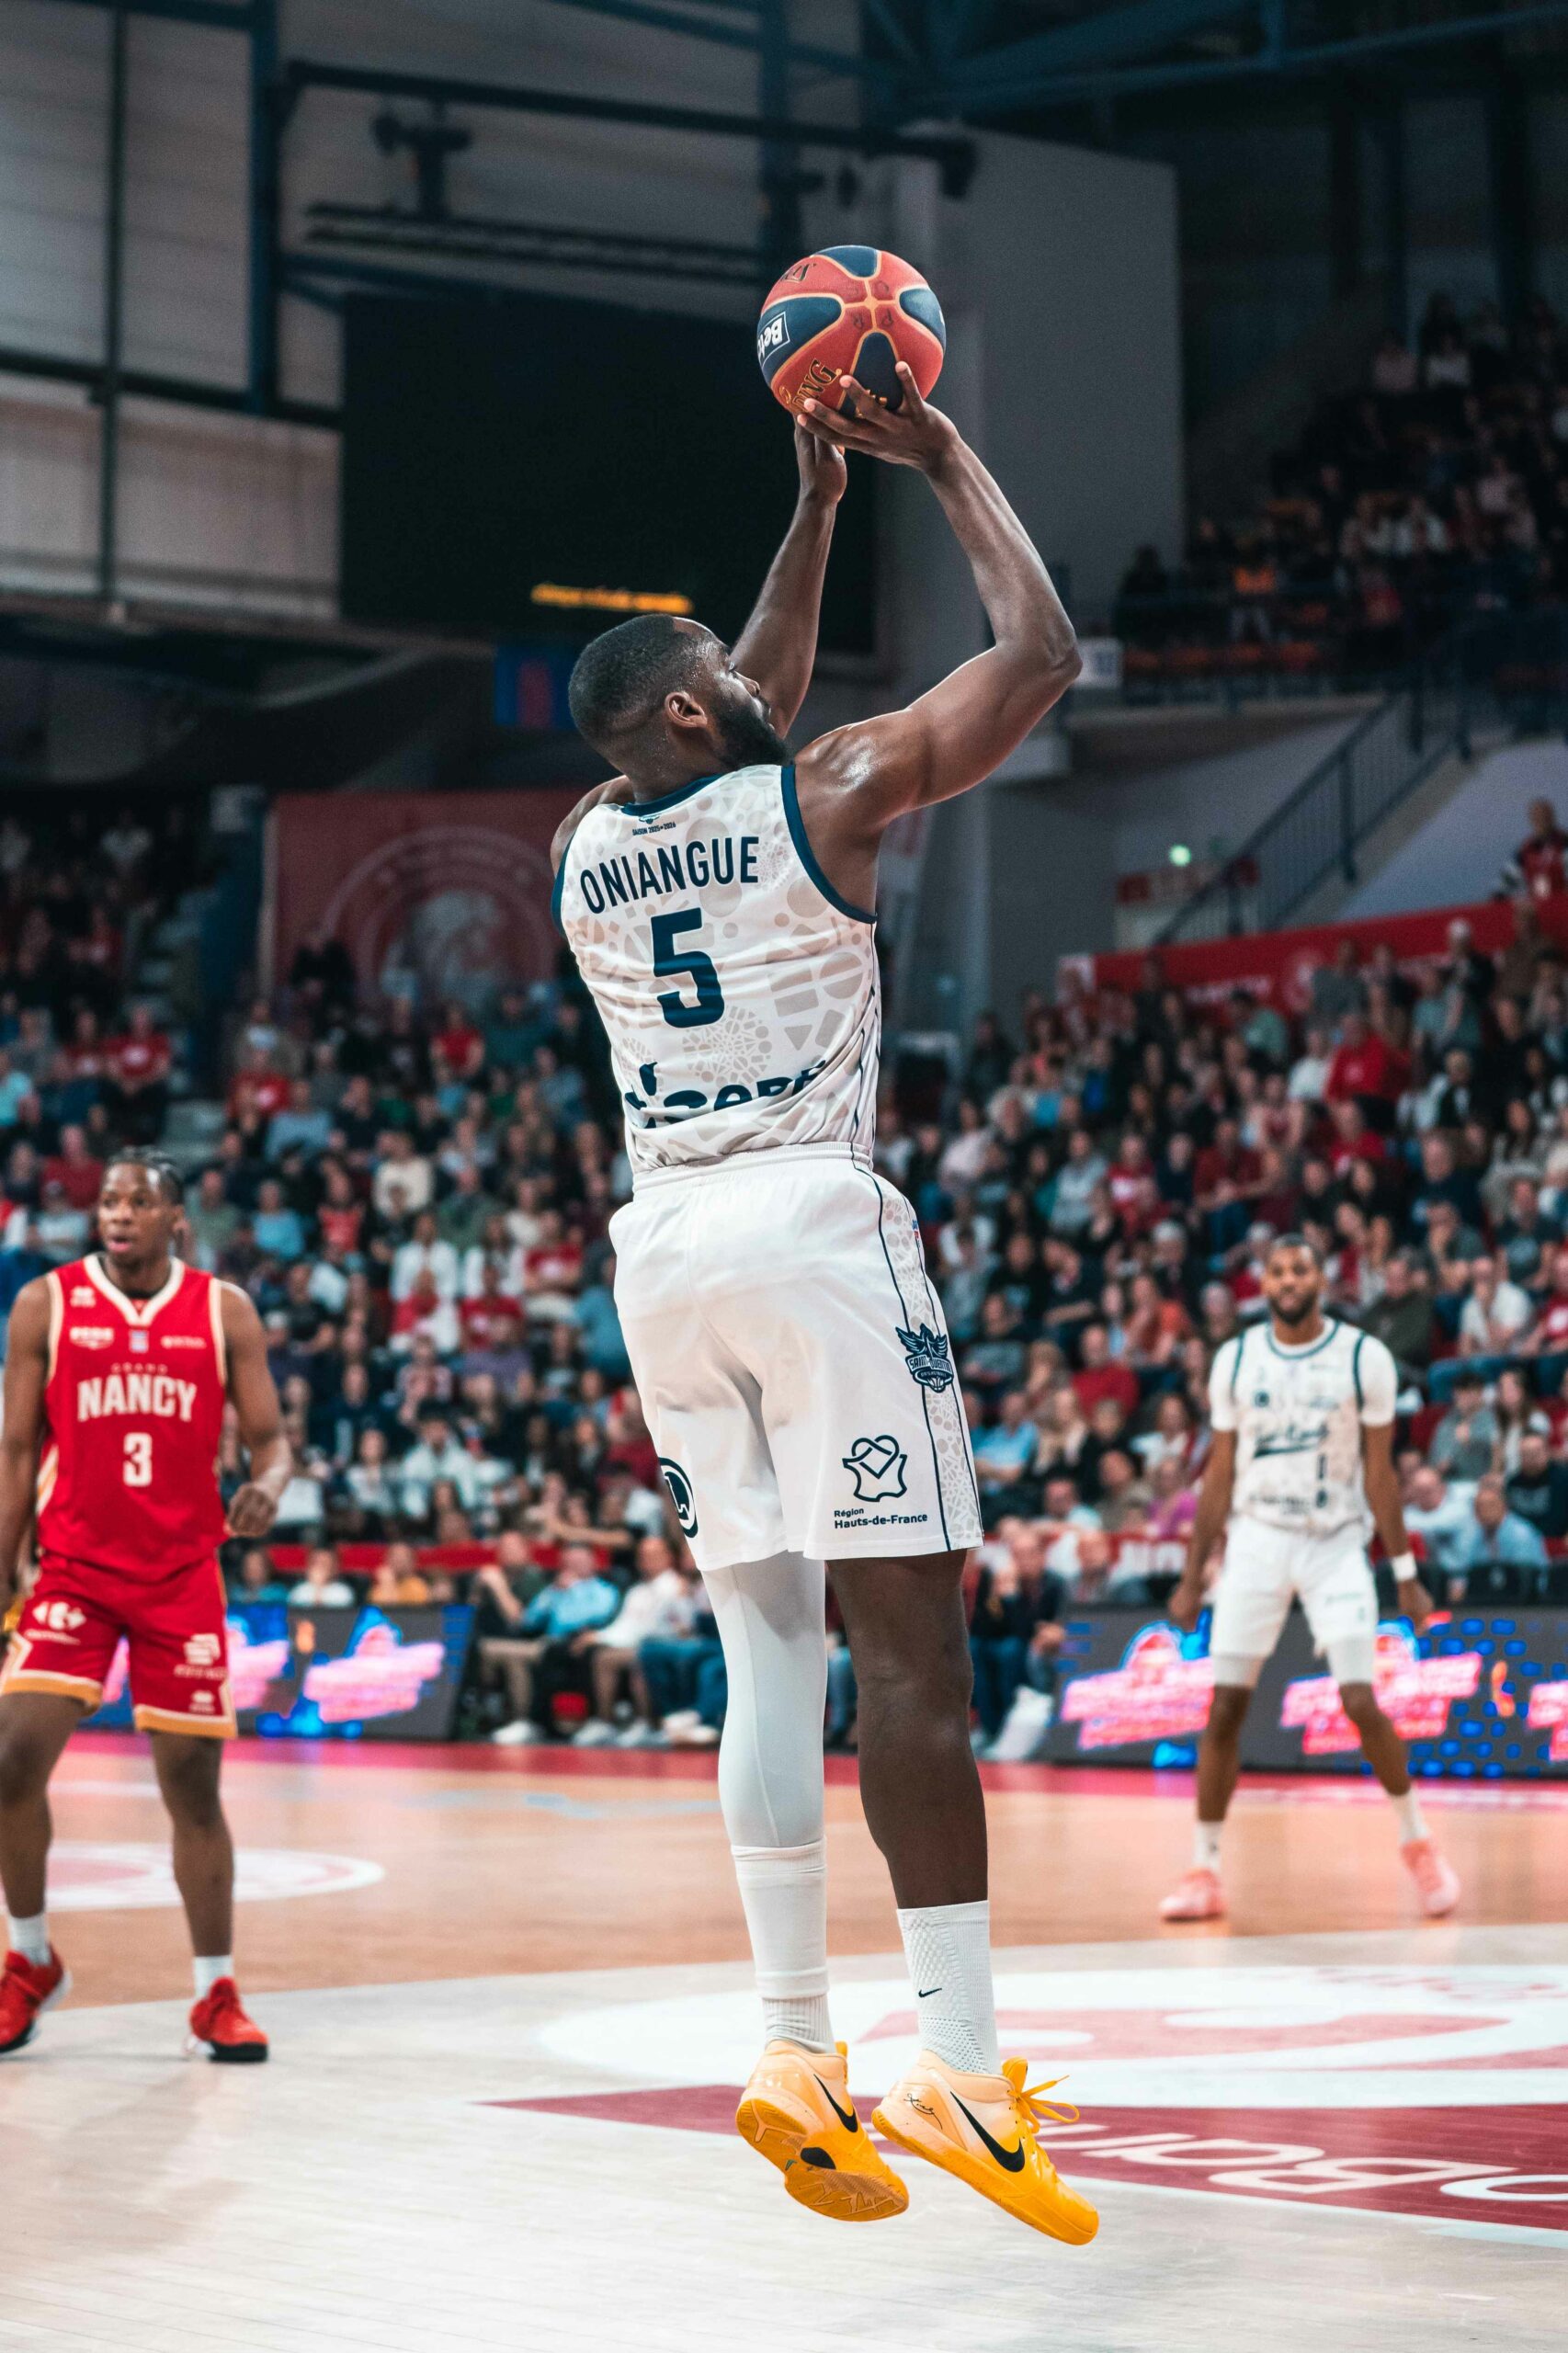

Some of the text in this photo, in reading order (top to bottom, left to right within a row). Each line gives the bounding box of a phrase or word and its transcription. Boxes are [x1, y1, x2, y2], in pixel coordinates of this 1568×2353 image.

[580, 836, 759, 915] ONIANGUE
[651, 907, 725, 1029] 5
[77, 1374, 197, 1422] NANCY
[123, 1433, 152, 1486] 3
[834, 1508, 864, 1518] Région
[834, 1513, 928, 1529] Hauts-de-France
